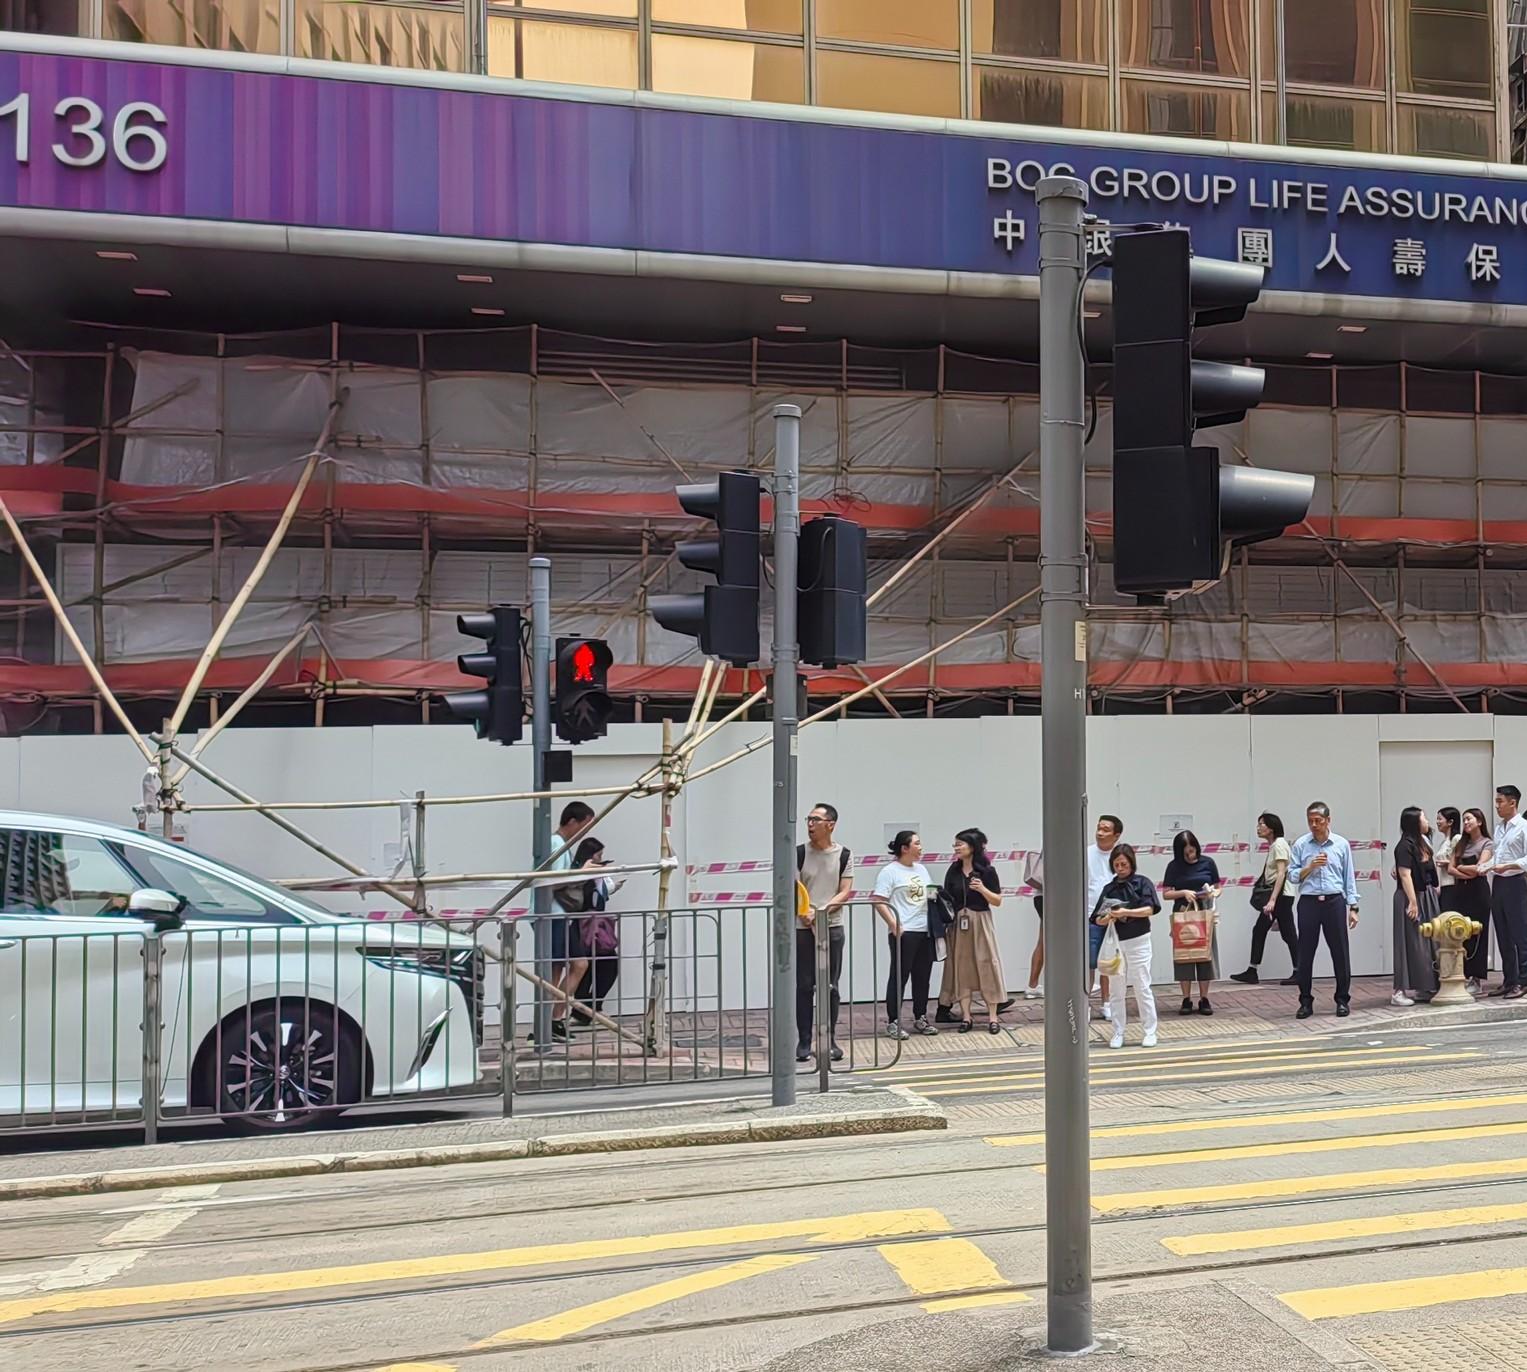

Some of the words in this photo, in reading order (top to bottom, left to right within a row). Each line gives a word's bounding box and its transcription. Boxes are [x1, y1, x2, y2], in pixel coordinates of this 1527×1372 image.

[0, 92, 168, 171] 136
[1090, 165, 1236, 205] GROUP
[1250, 177, 1329, 213] LIFE
